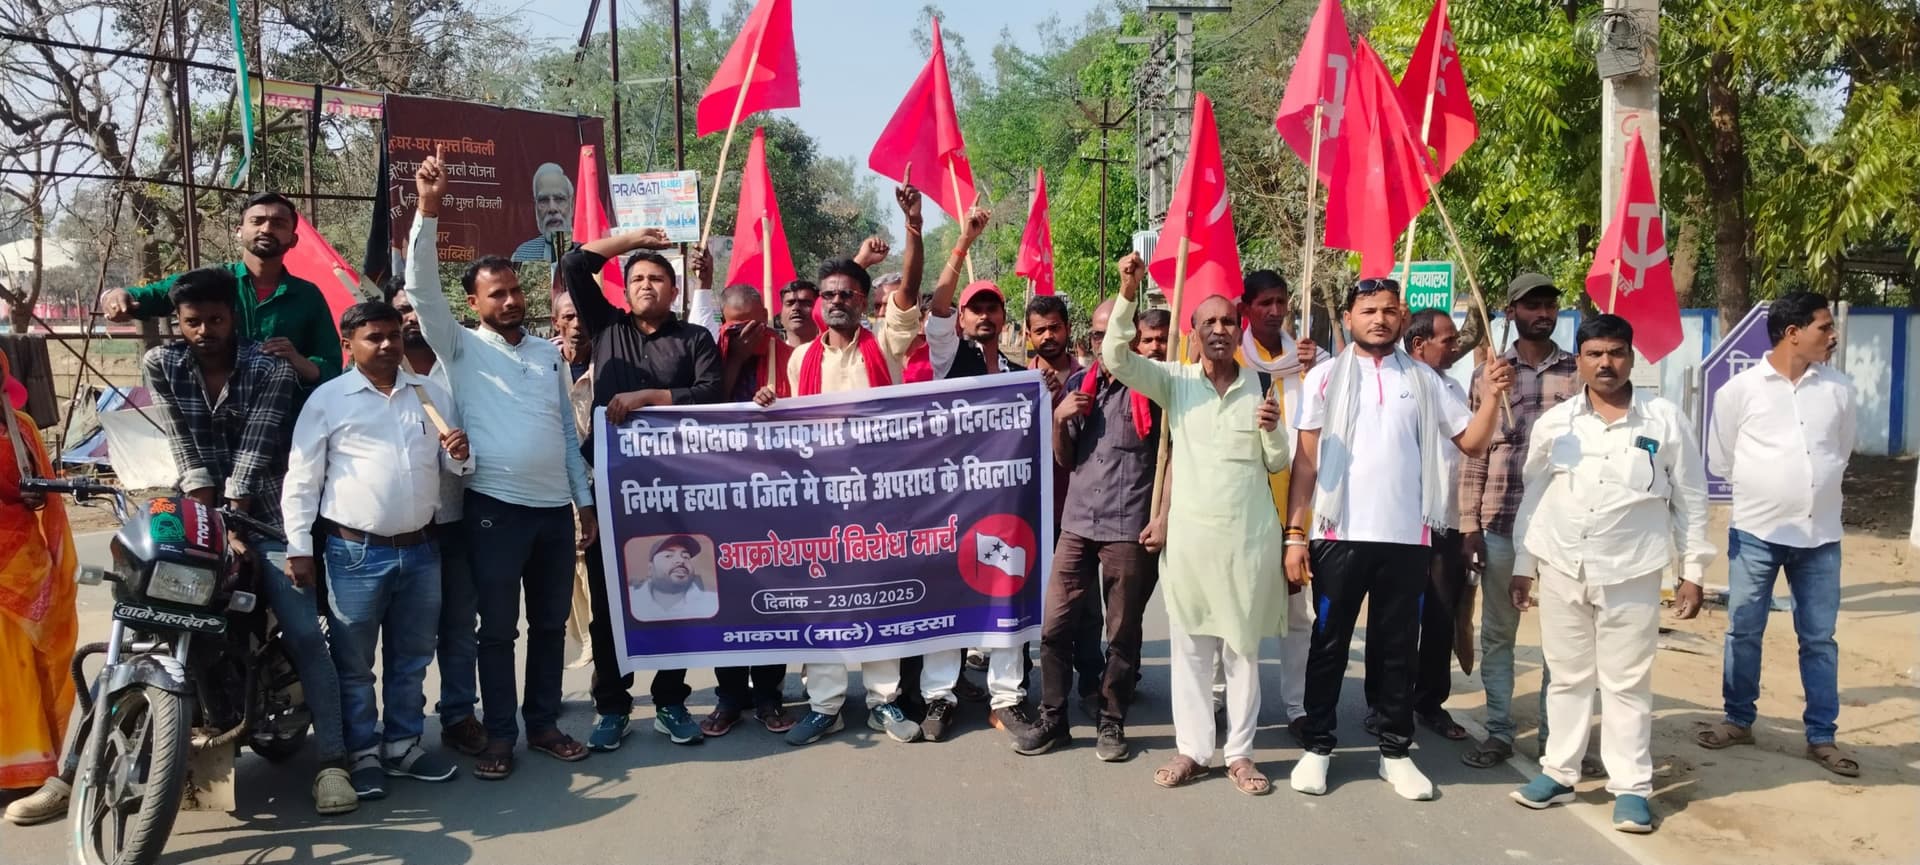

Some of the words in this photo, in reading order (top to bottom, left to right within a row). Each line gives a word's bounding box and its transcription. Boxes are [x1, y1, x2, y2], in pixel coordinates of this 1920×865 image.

[462, 137, 495, 156] बिजली
[468, 162, 496, 178] योजना
[613, 181, 660, 196] PRAGATI
[441, 194, 454, 207] की
[476, 195, 502, 209] बिजली
[1409, 292, 1449, 308] COURT
[617, 418, 676, 457] दलित
[679, 417, 749, 454] शिक्षक
[752, 418, 845, 459] राजकुमार
[848, 411, 925, 445] पासवान
[927, 401, 950, 437] के
[950, 392, 1033, 436] दिनदहाड़े
[620, 477, 679, 515] निर्मम
[681, 483, 728, 512] हत्या
[729, 481, 748, 510] व
[750, 471, 798, 509] जिले
[801, 469, 821, 505] मे
[822, 466, 868, 510] बढ़ते
[938, 457, 960, 493] के
[962, 454, 1033, 491] खिलाफ
[717, 525, 841, 579] आक्रोशपूर्ण
[843, 522, 907, 563] विरोध
[911, 514, 958, 556] मार्च
[763, 592, 809, 610] दिनांक
[828, 587, 915, 608] 23/03/2025
[153, 611, 205, 628] महादेव
[723, 629, 800, 644] भाकपा
[804, 621, 874, 646] (माले)
[878, 614, 956, 637] सहरसा
